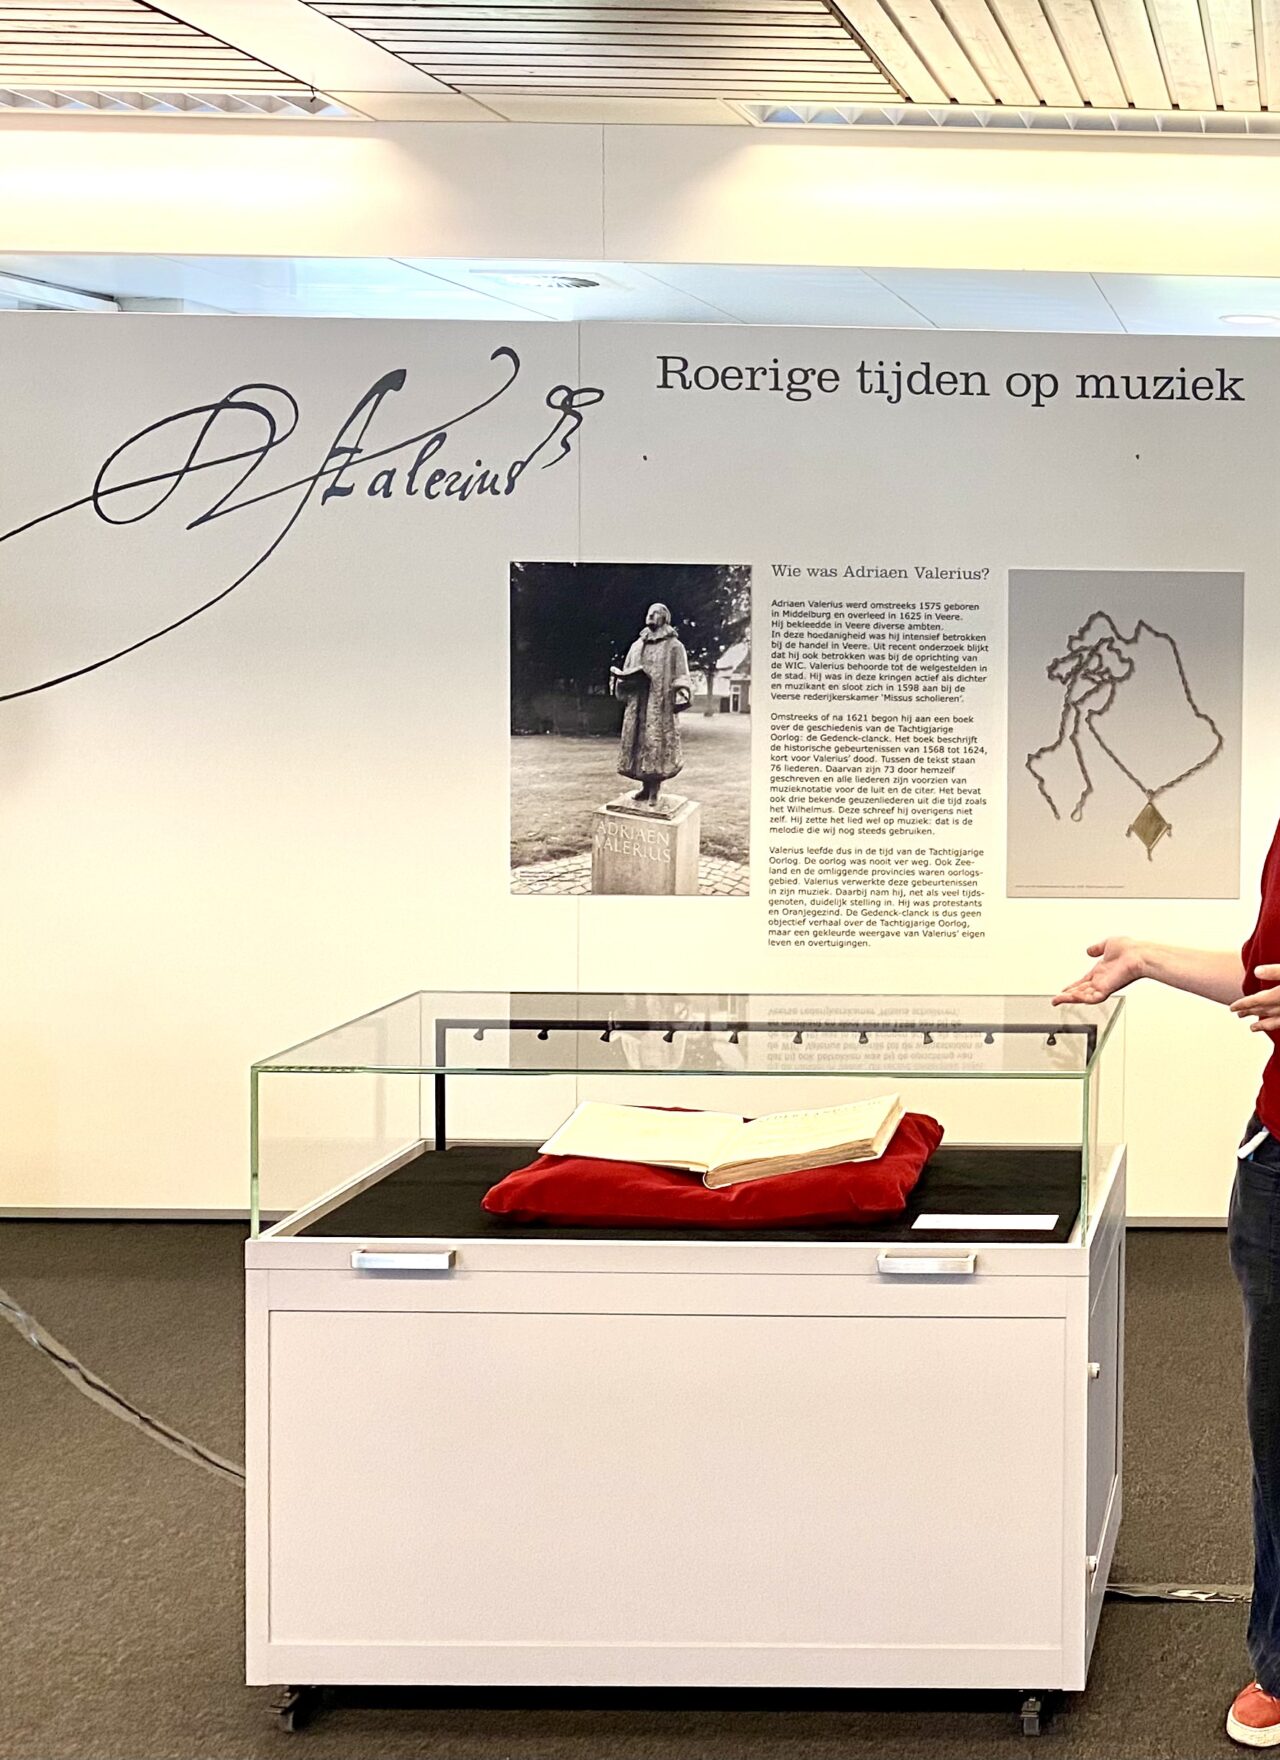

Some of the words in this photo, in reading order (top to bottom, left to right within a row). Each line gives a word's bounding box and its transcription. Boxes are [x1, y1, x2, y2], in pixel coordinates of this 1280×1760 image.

[656, 355, 840, 403] Roerige
[856, 360, 990, 406] tijden
[1006, 372, 1058, 408] op
[1076, 365, 1245, 402] muziek
[771, 564, 801, 577] Wie
[806, 568, 838, 577] was
[843, 565, 908, 579] Adriaen
[914, 566, 989, 580] Valerius?
[771, 599, 805, 608] Adriaen
[808, 600, 843, 608] Valerius
[846, 601, 867, 609] werd
[870, 601, 916, 610] omstreeks
[920, 602, 941, 610] 1575
[944, 603, 979, 612] geboren
[771, 609, 779, 617] in
[782, 610, 831, 619] Middelburg
[847, 611, 885, 620] overleed
[900, 611, 922, 620] 1625
[924, 612, 932, 620] in
[935, 613, 963, 621] Veere.
[771, 620, 784, 629] Hij
[786, 620, 831, 629] bekleedde
[834, 621, 842, 629] in
[845, 622, 871, 630] Veere
[873, 622, 905, 630] diverse
[907, 622, 944, 631] ambten.
[772, 630, 781, 638] In
[783, 630, 804, 639] deze
[807, 631, 866, 640] hoedanigheid
[889, 632, 900, 641] hij
[902, 632, 940, 641] intensief
[943, 633, 986, 642] betrokken
[771, 640, 782, 649] bij
[785, 641, 796, 649] de
[799, 641, 828, 649] handel
[831, 641, 839, 649] in
[842, 642, 870, 650] Veere.
[888, 643, 916, 651] recent
[919, 643, 964, 652] onderzoek
[967, 644, 989, 653] blijkt
[771, 651, 786, 659] dat
[788, 651, 799, 660] hij
[802, 651, 818, 659] ook
[821, 651, 865, 660] betrokken
[888, 653, 899, 662] bij
[902, 653, 913, 661] de
[915, 653, 959, 662] oprichting
[771, 661, 782, 669] de
[809, 662, 844, 670] Valerius
[847, 663, 889, 671] behoorde
[906, 663, 917, 672] de
[920, 663, 977, 673] welgestelden
[785, 671, 806, 680] stad.
[810, 672, 822, 681] Hij
[855, 673, 876, 681] deze
[879, 673, 912, 682] kringen
[915, 673, 939, 682] actief
[941, 674, 954, 682] als
[956, 674, 987, 683] dichter
[785, 682, 825, 690] muzikant
[842, 683, 863, 691] sloot
[866, 683, 883, 691] zich
[898, 683, 919, 692] 1598
[941, 685, 952, 693] bij
[771, 692, 801, 700] Veerse
[803, 693, 879, 702] rederijkerskamer
[596, 820, 670, 846] ADRIAEN
[594, 834, 671, 863] VALERIUS
[813, 929, 856, 937] gekleurde
[859, 930, 900, 938] weergave
[962, 931, 985, 939] eigen
[808, 939, 870, 948] overtuigingen.
